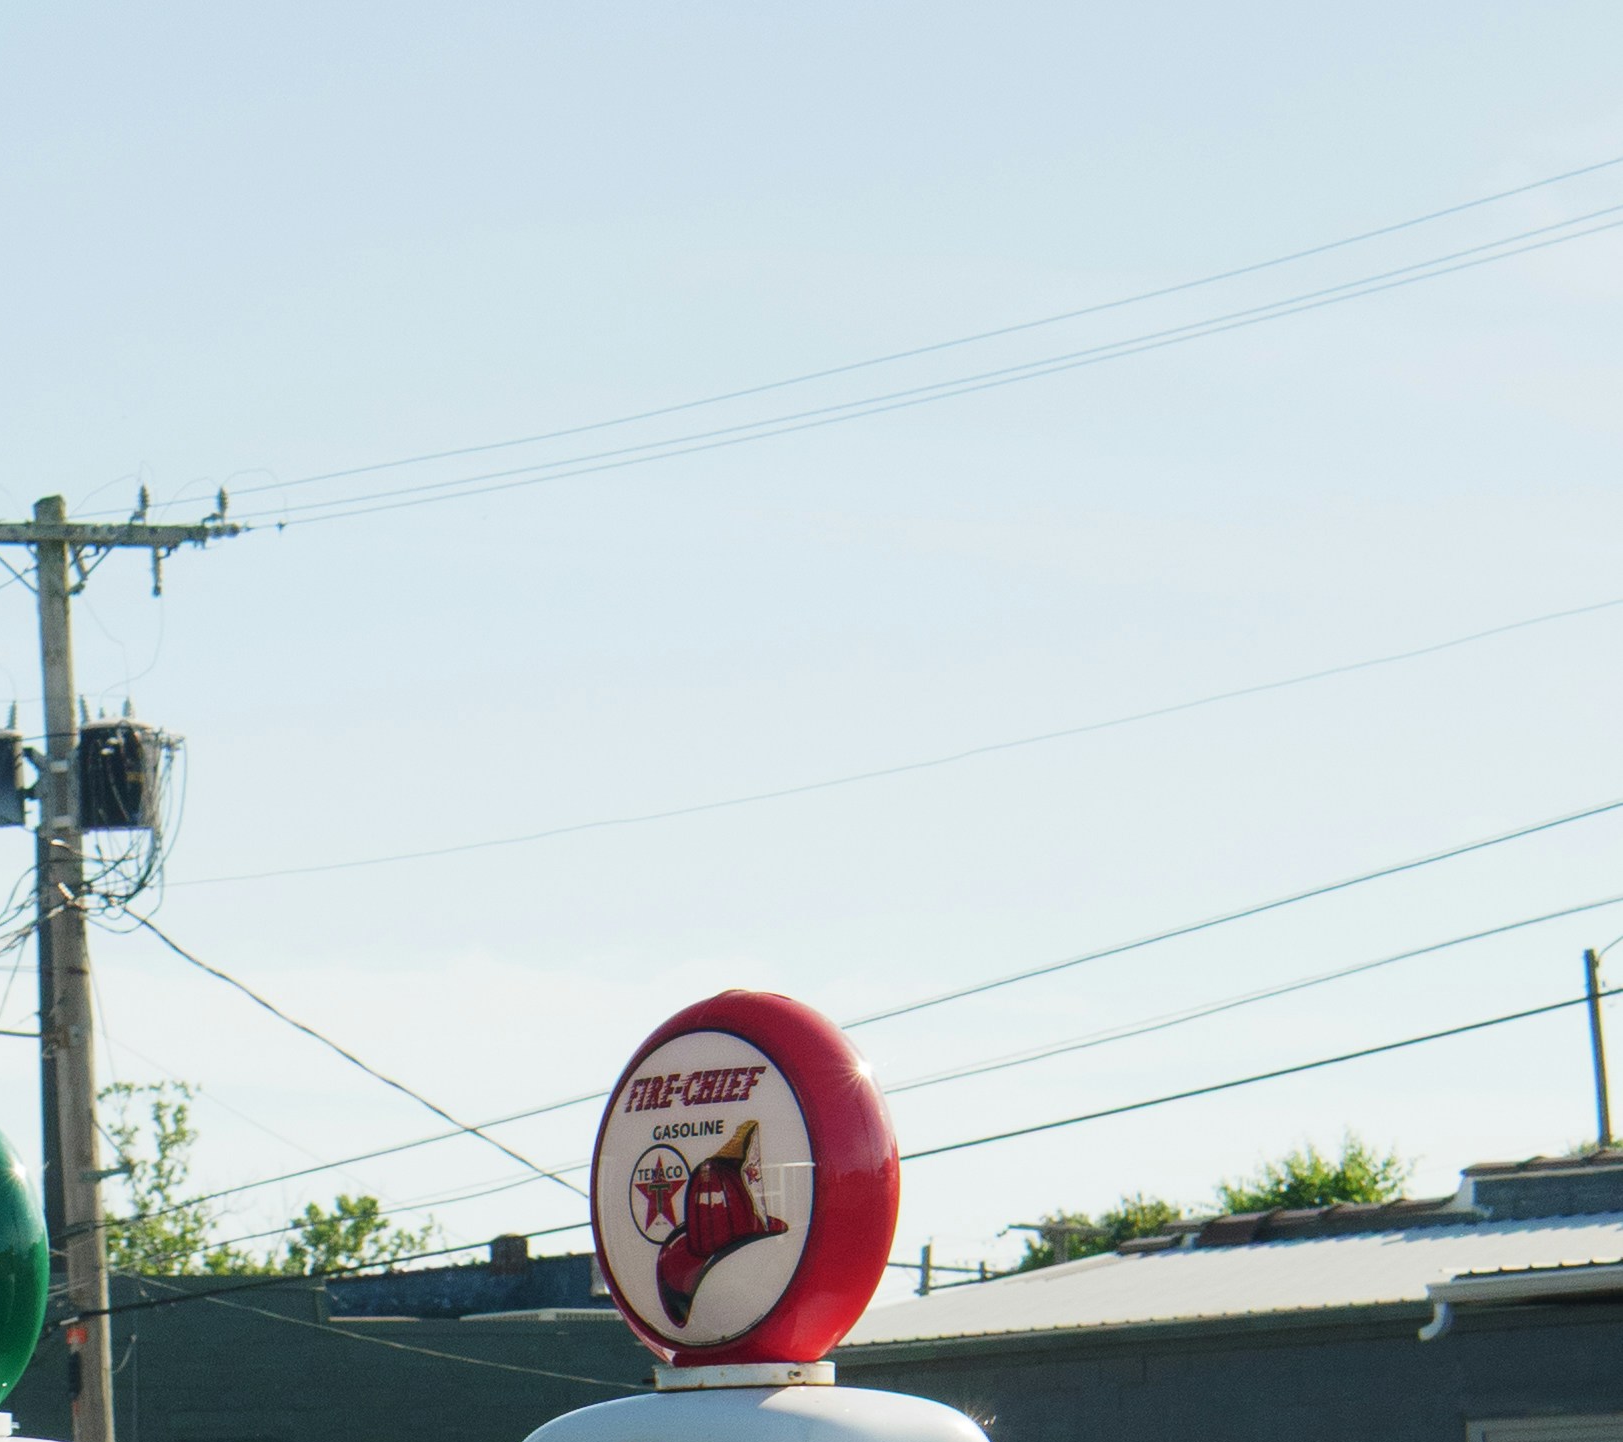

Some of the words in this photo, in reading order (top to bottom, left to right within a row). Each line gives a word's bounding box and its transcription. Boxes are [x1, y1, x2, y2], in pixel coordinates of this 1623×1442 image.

[624, 1066, 767, 1113] FIRE-CHIEF
[652, 1119, 724, 1141] GASOLINE
[637, 1165, 683, 1181] TEXACO
[648, 1183, 672, 1215] T
